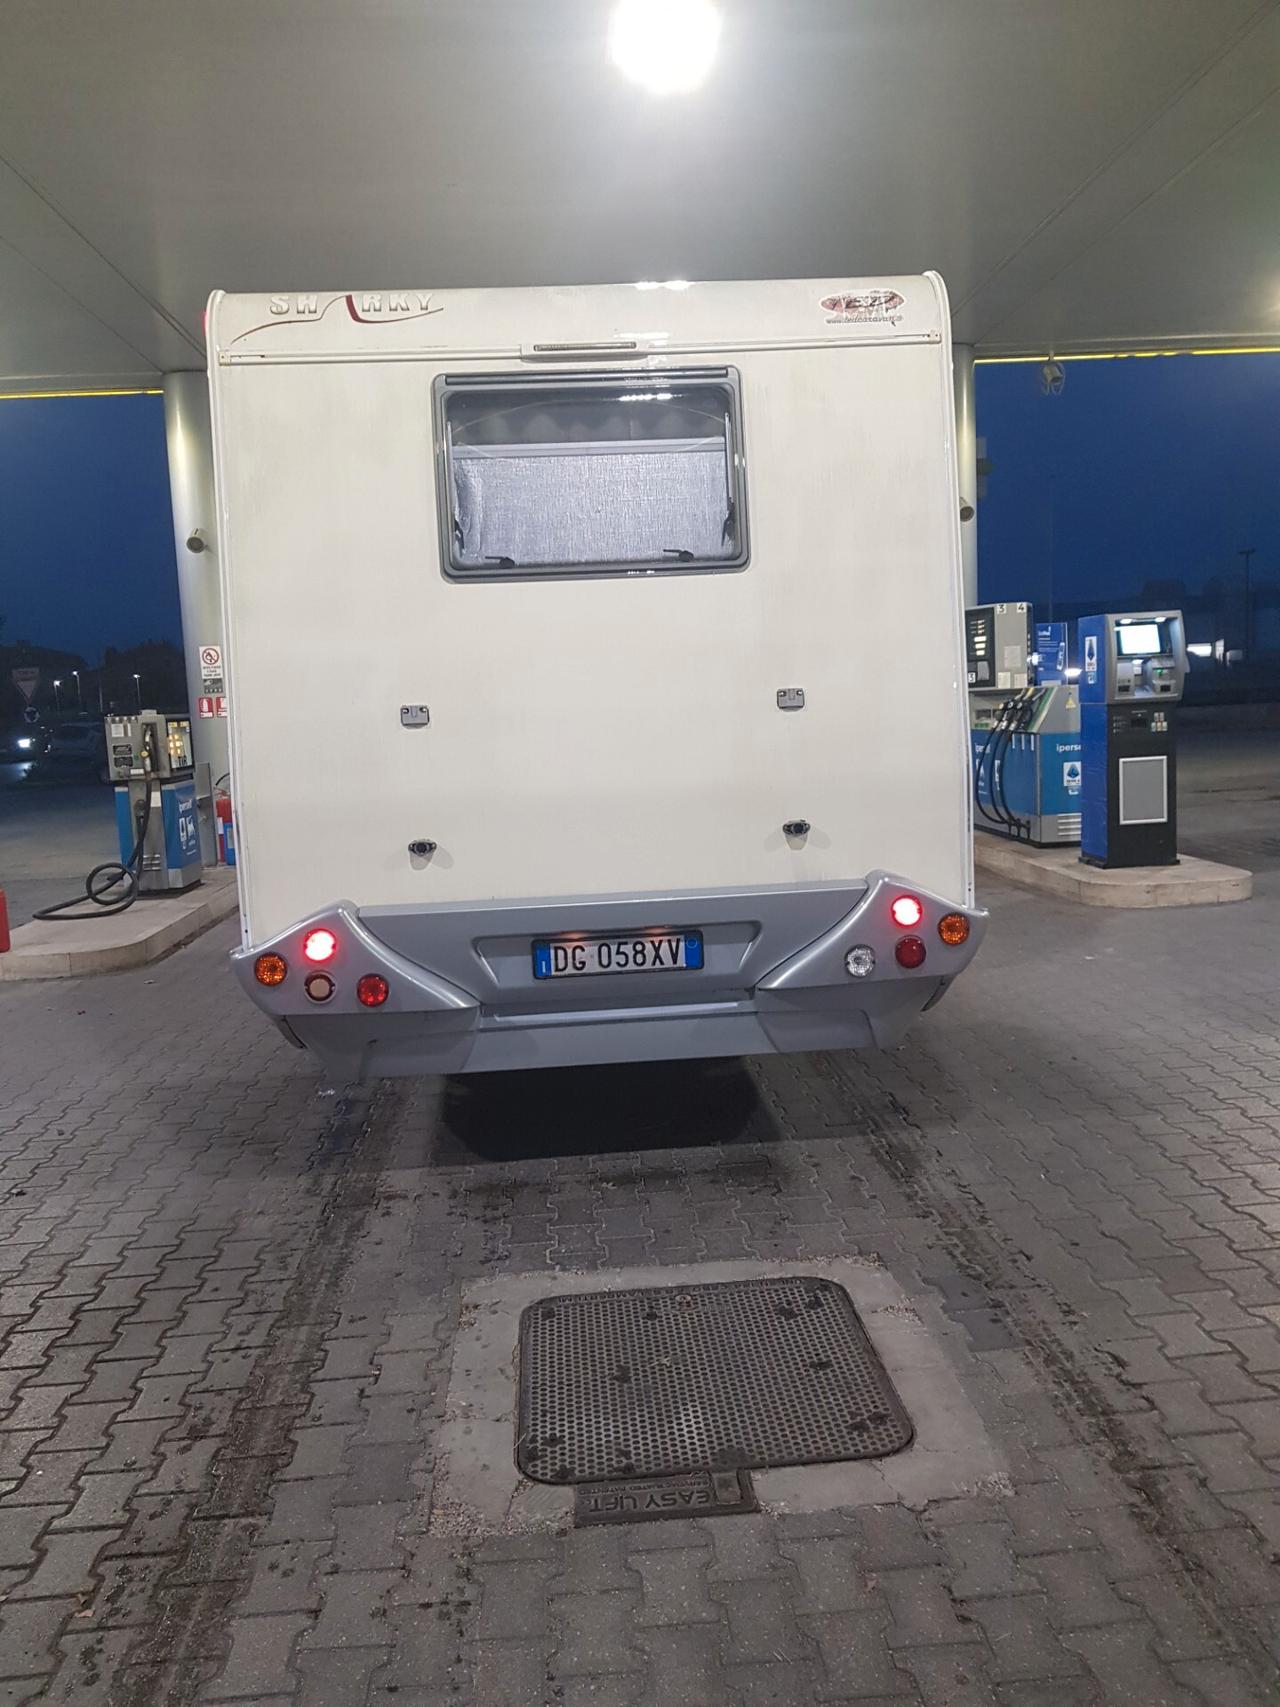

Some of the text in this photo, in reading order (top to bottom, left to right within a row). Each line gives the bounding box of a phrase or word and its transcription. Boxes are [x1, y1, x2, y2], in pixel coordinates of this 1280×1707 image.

[553, 944, 587, 973] DG
[597, 937, 682, 969] 058XV
[589, 1495, 638, 1513] LIFT
[645, 1489, 711, 1509] EASY
